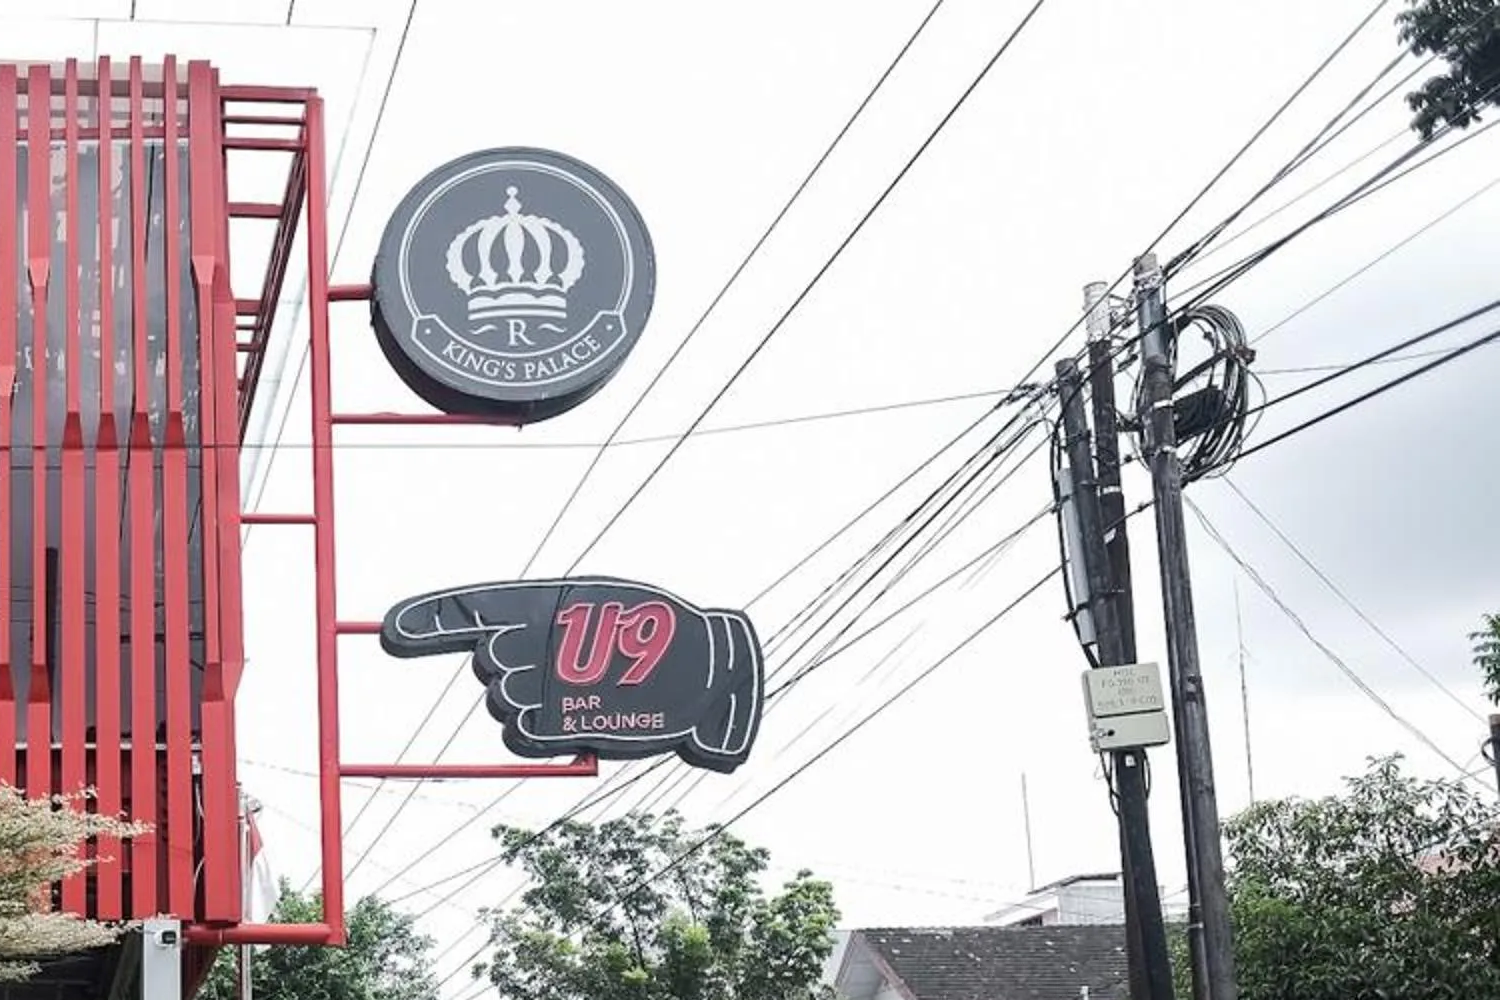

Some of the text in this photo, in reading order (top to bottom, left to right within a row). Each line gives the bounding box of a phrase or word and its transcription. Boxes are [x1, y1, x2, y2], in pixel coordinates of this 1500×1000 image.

[505, 318, 536, 346] R
[442, 334, 601, 380] KING'S PALACE
[556, 601, 676, 686] U9
[562, 695, 602, 713] BAR
[563, 712, 665, 732] & LOUNGE
